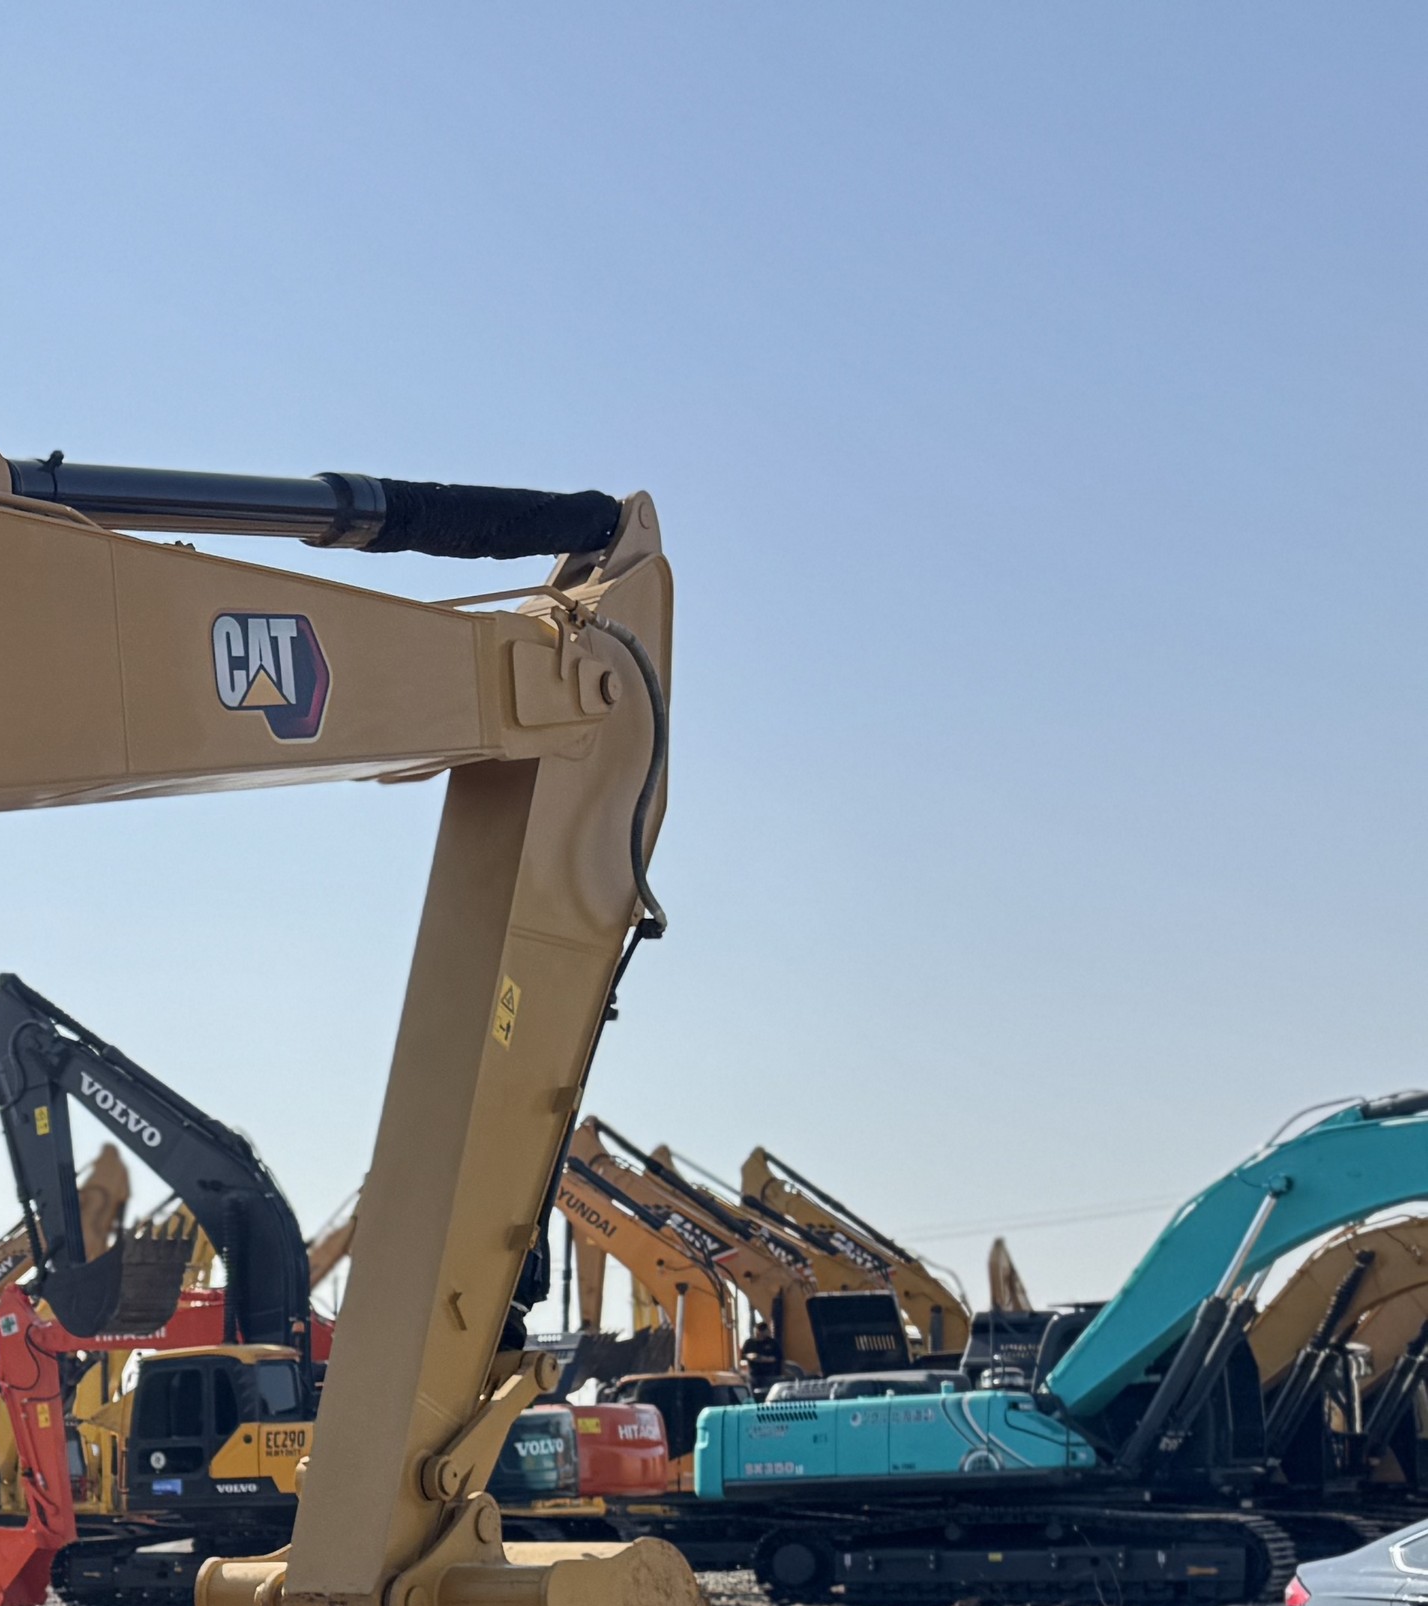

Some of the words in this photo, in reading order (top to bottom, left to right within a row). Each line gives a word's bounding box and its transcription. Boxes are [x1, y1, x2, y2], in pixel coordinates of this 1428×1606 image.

[213, 615, 298, 708] CAT
[80, 1071, 162, 1148] VOLVO
[557, 1186, 618, 1239] YUNDAI
[266, 1430, 305, 1449] EC290
[514, 1438, 564, 1457] VOLVO
[216, 1482, 258, 1493] VOLVO
